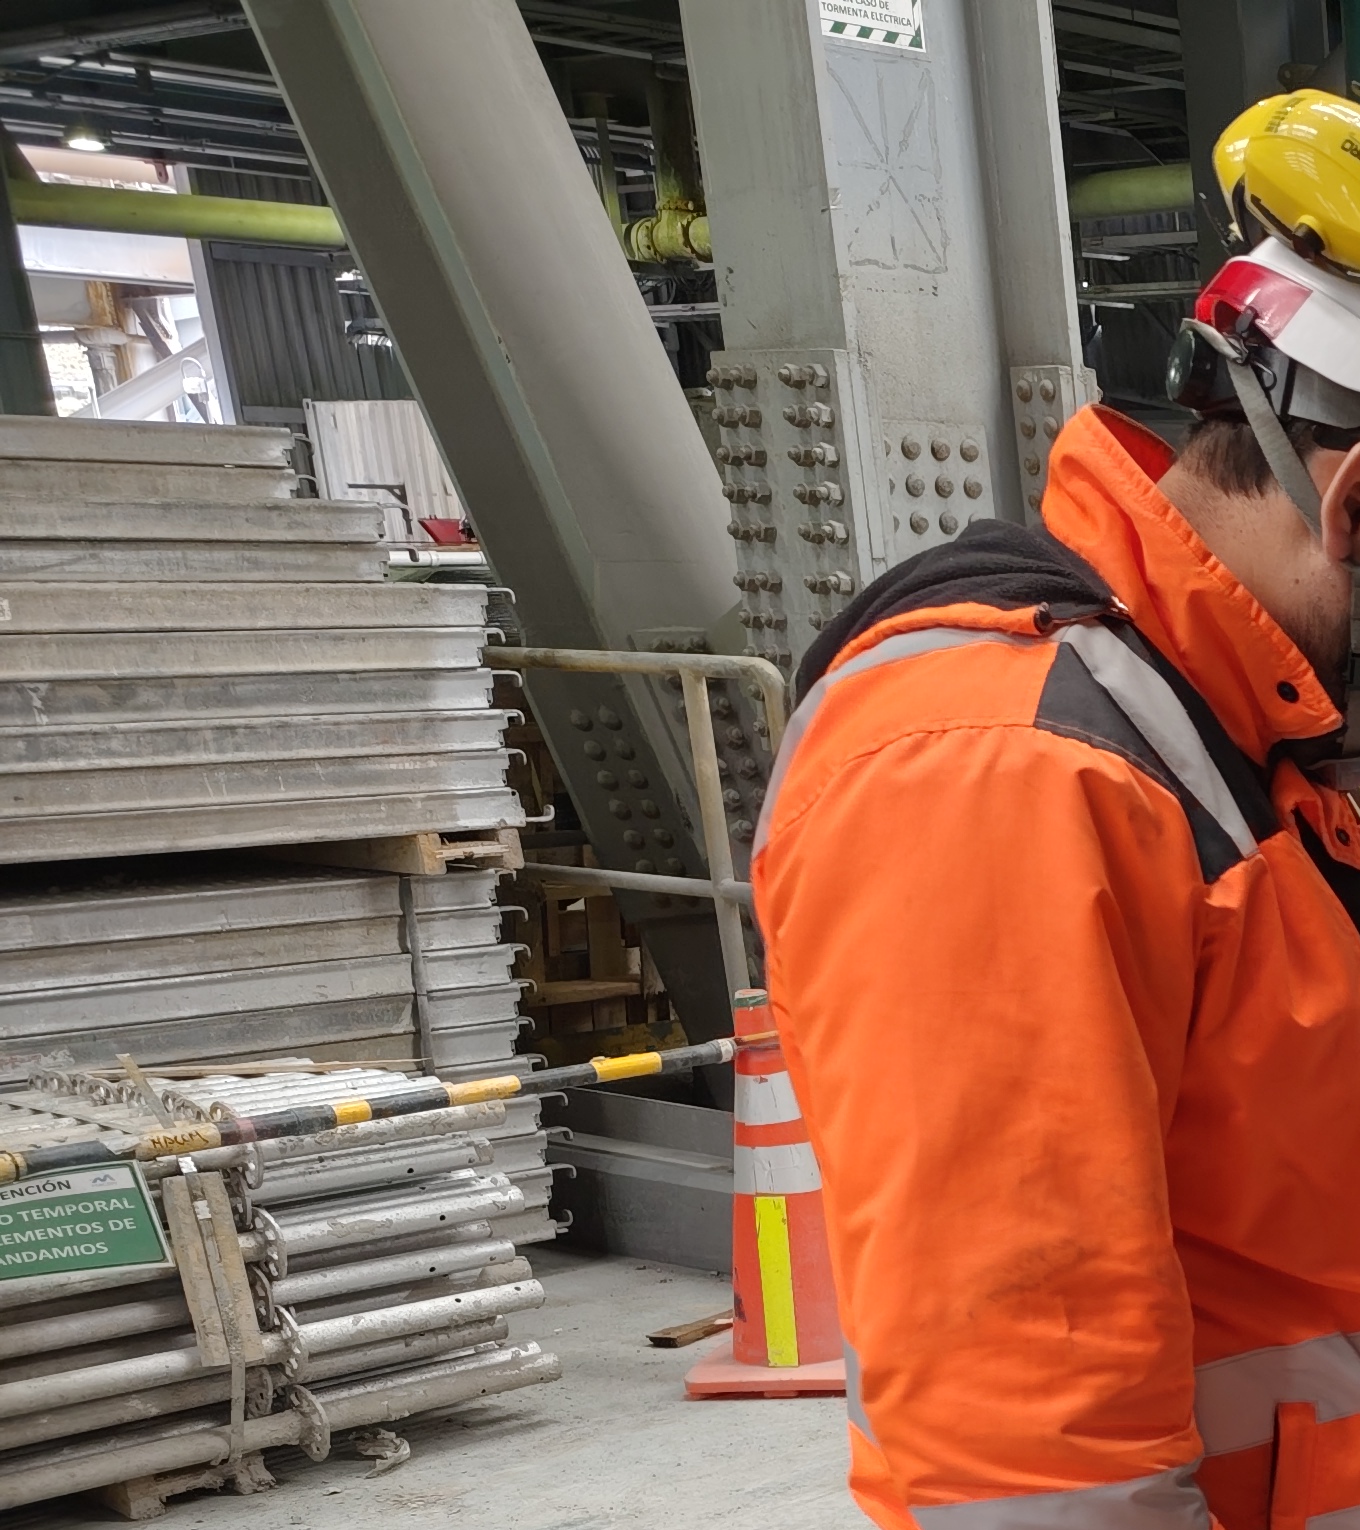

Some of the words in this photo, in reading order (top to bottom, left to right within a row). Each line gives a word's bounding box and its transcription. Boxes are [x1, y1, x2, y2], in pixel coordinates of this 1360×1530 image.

[821, 2, 869, 19] TORMENTA
[871, 11, 912, 27] ELECTRICA
[17, 1197, 135, 1222] TEMPORAL
[108, 1217, 137, 1231] DE
